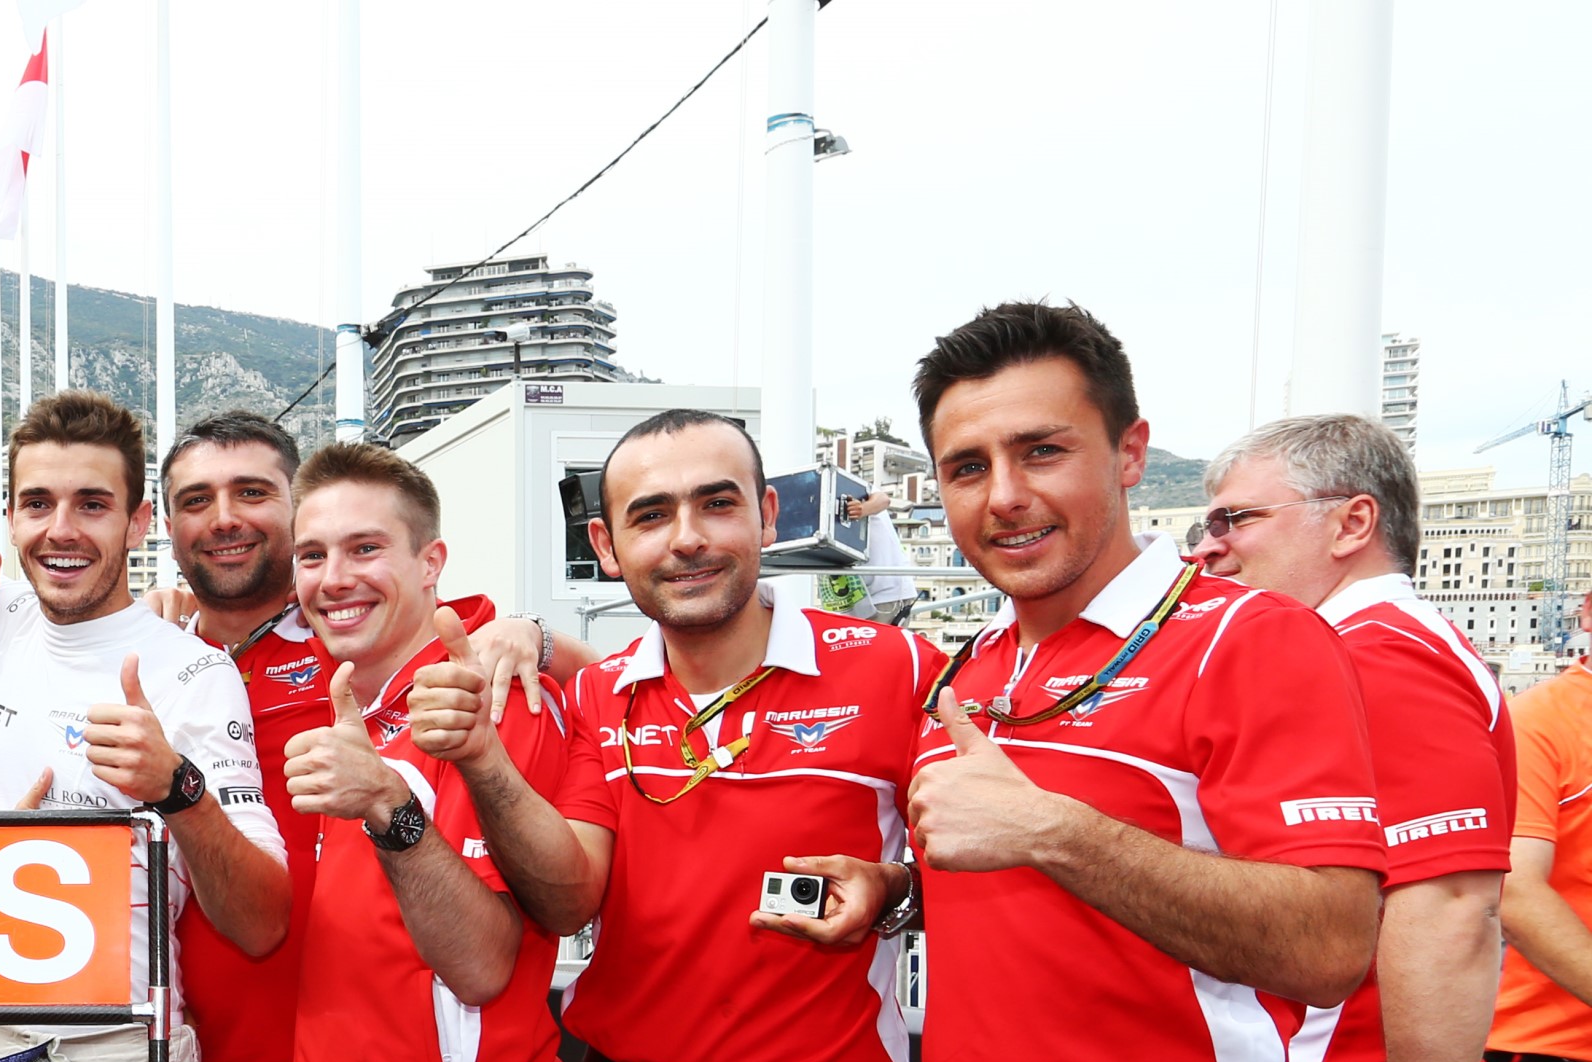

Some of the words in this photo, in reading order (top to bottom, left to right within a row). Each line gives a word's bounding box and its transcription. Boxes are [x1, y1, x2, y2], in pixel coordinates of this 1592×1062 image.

[822, 626, 877, 644] one
[1128, 628, 1151, 654] GRID
[177, 651, 234, 683] sparc
[266, 655, 318, 675] MARUS
[1045, 675, 1149, 688] MARSIA
[49, 709, 90, 724] MARU
[765, 705, 860, 722] MARUSSIA
[62, 790, 108, 809] ROAD
[1279, 796, 1381, 826] PIREL
[1383, 807, 1488, 848] PIRELLI
